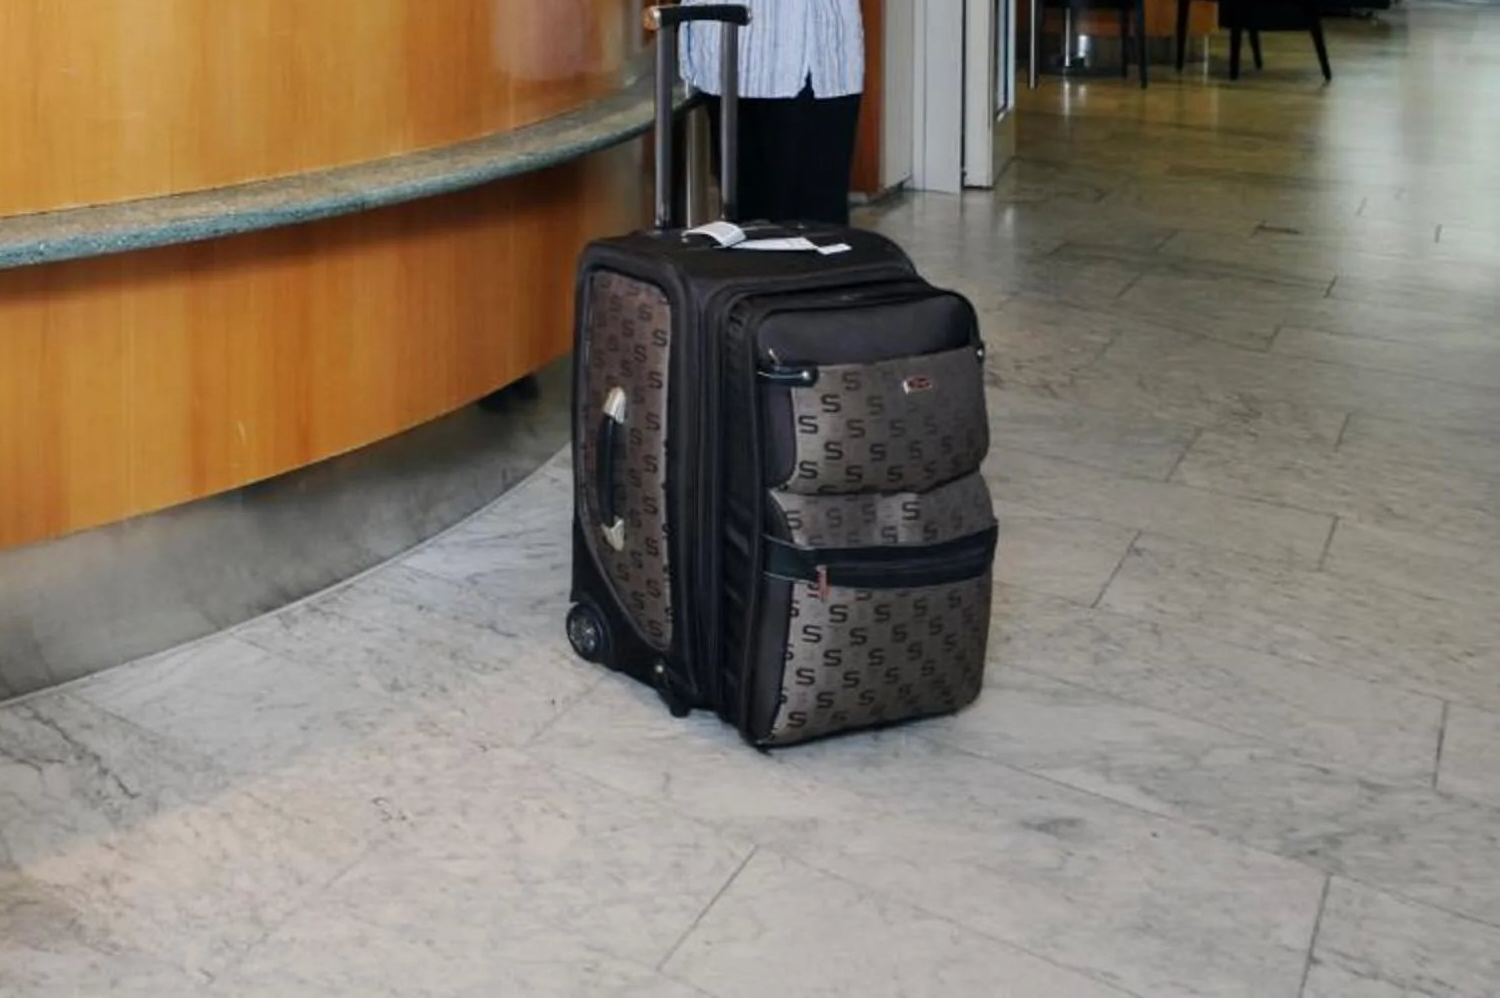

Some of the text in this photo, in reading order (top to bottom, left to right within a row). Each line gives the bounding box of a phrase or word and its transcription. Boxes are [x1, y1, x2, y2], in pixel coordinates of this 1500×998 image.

[821, 394, 841, 413] S
[799, 415, 818, 434] S
[824, 441, 844, 460] S
[799, 460, 818, 479] S
[829, 604, 848, 623] S
[802, 625, 822, 643] S
[823, 649, 842, 667] S
[796, 668, 815, 685] S
